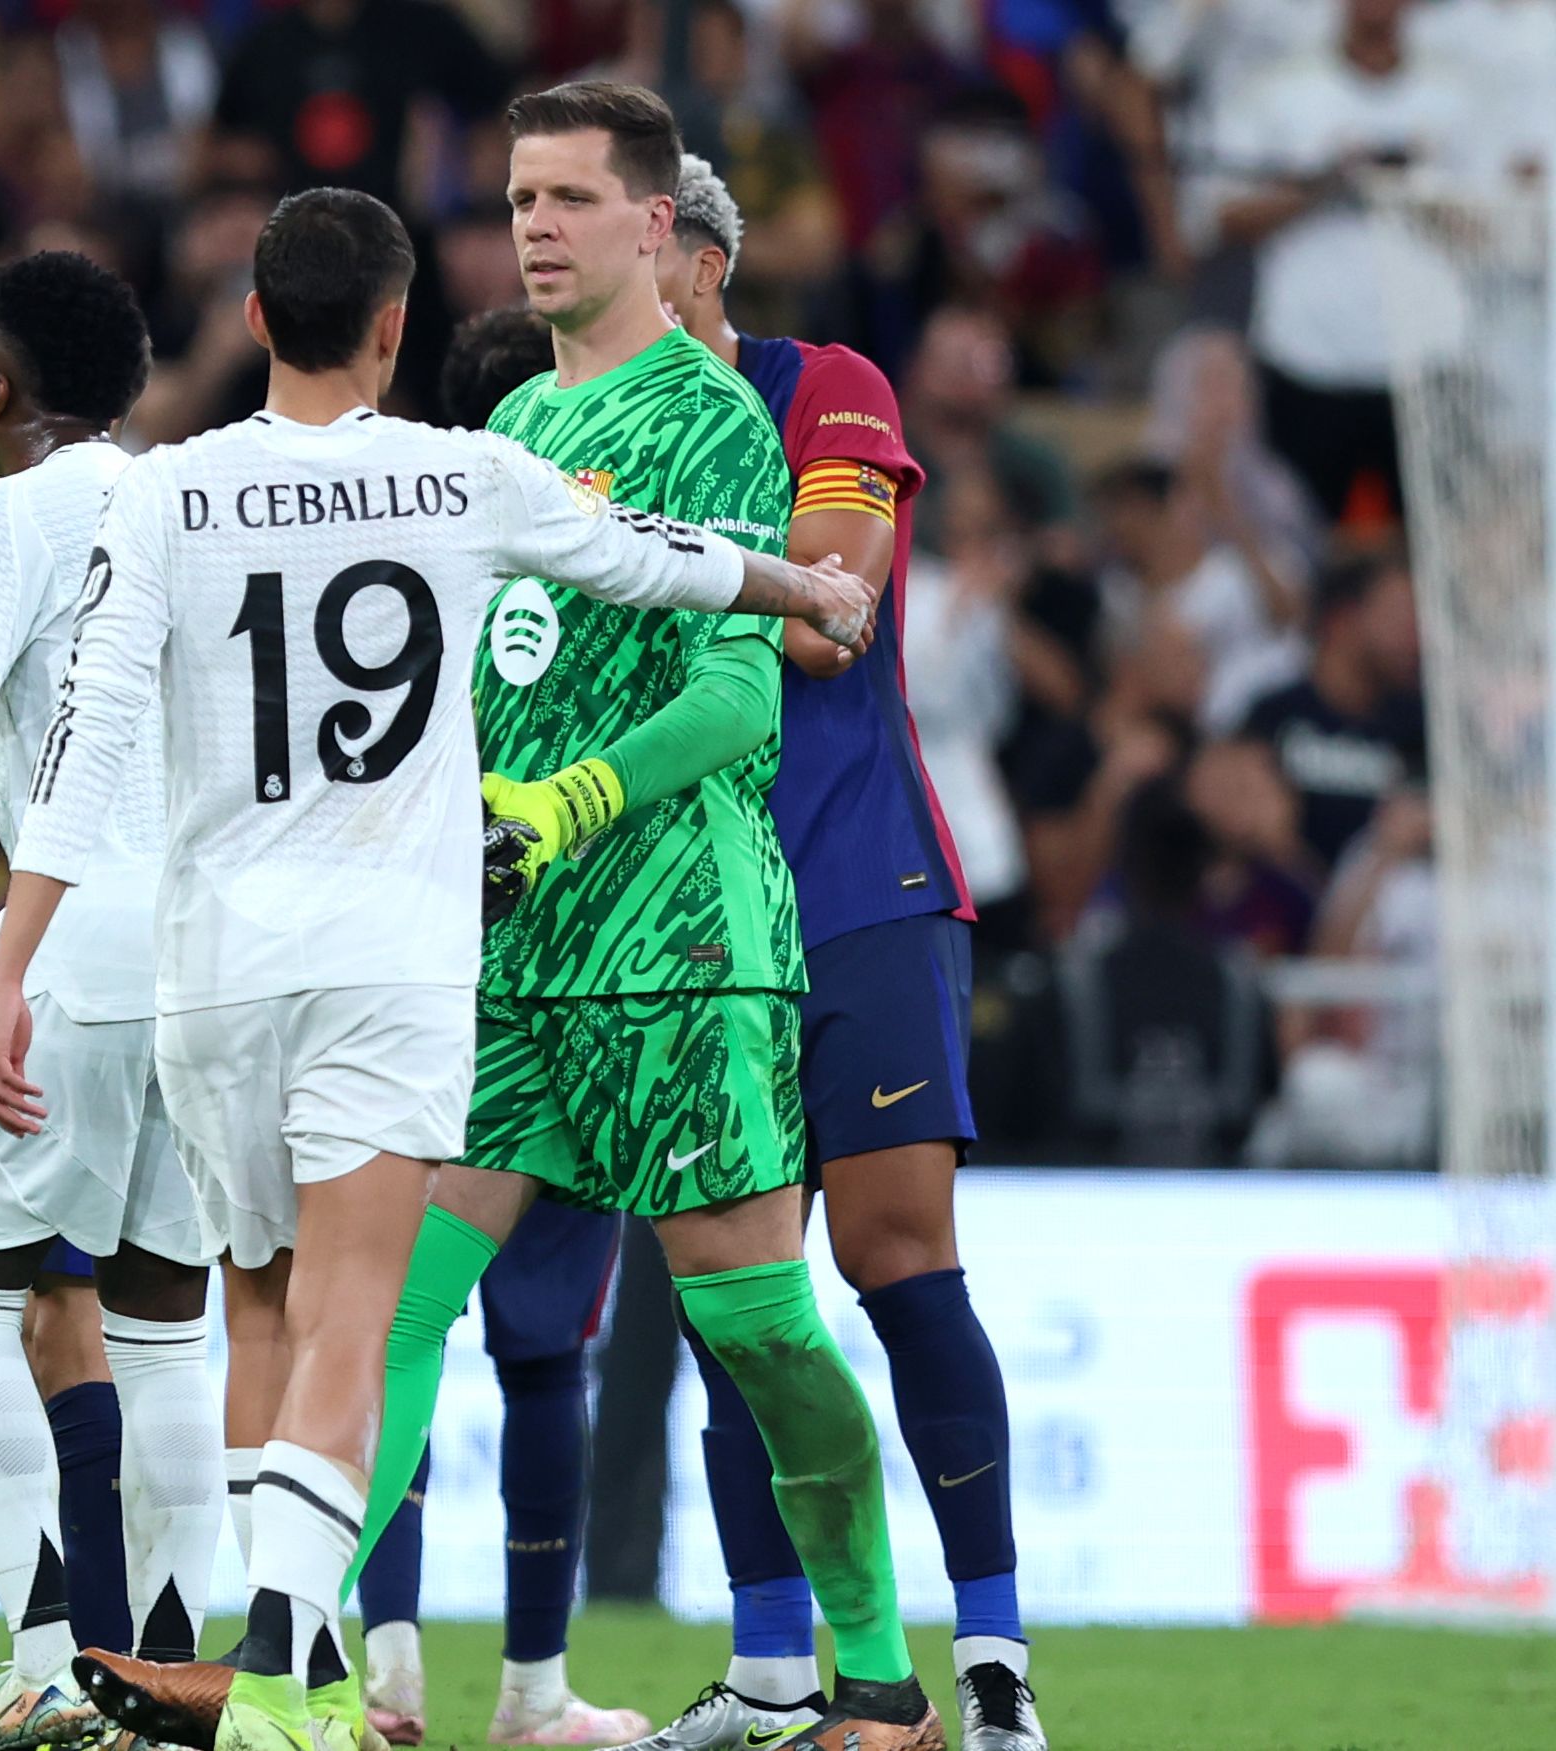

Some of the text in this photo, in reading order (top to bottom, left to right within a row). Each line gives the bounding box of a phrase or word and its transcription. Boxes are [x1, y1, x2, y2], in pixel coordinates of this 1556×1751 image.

[818, 411, 890, 436] AMBILIGHT
[181, 472, 469, 531] D. CEBALLOS
[703, 517, 776, 541] AMBILIGHT
[227, 559, 444, 804] 19
